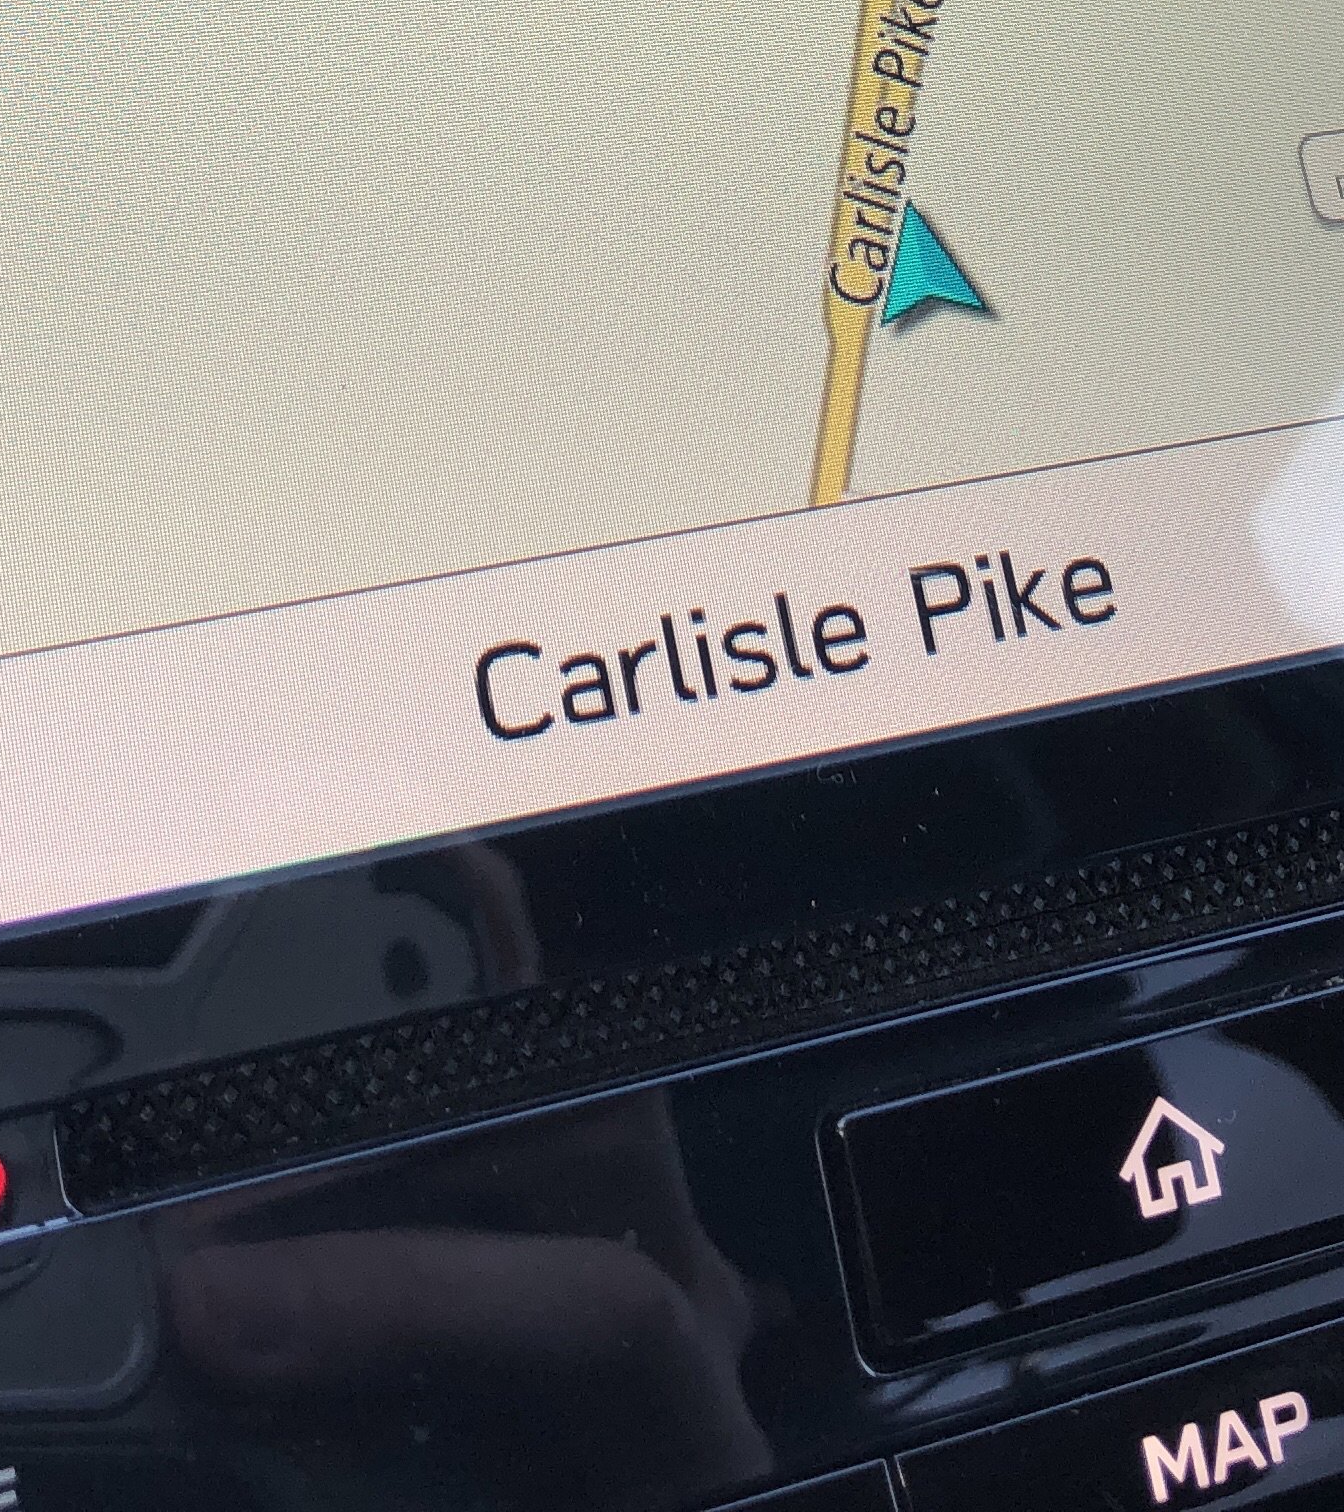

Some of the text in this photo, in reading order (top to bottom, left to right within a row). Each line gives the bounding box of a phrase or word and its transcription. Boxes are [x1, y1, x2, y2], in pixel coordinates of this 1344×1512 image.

[829, 104, 917, 307] Carlisle
[473, 549, 1119, 743] Carlisle Pike
[1140, 1390, 1311, 1504] MAP
